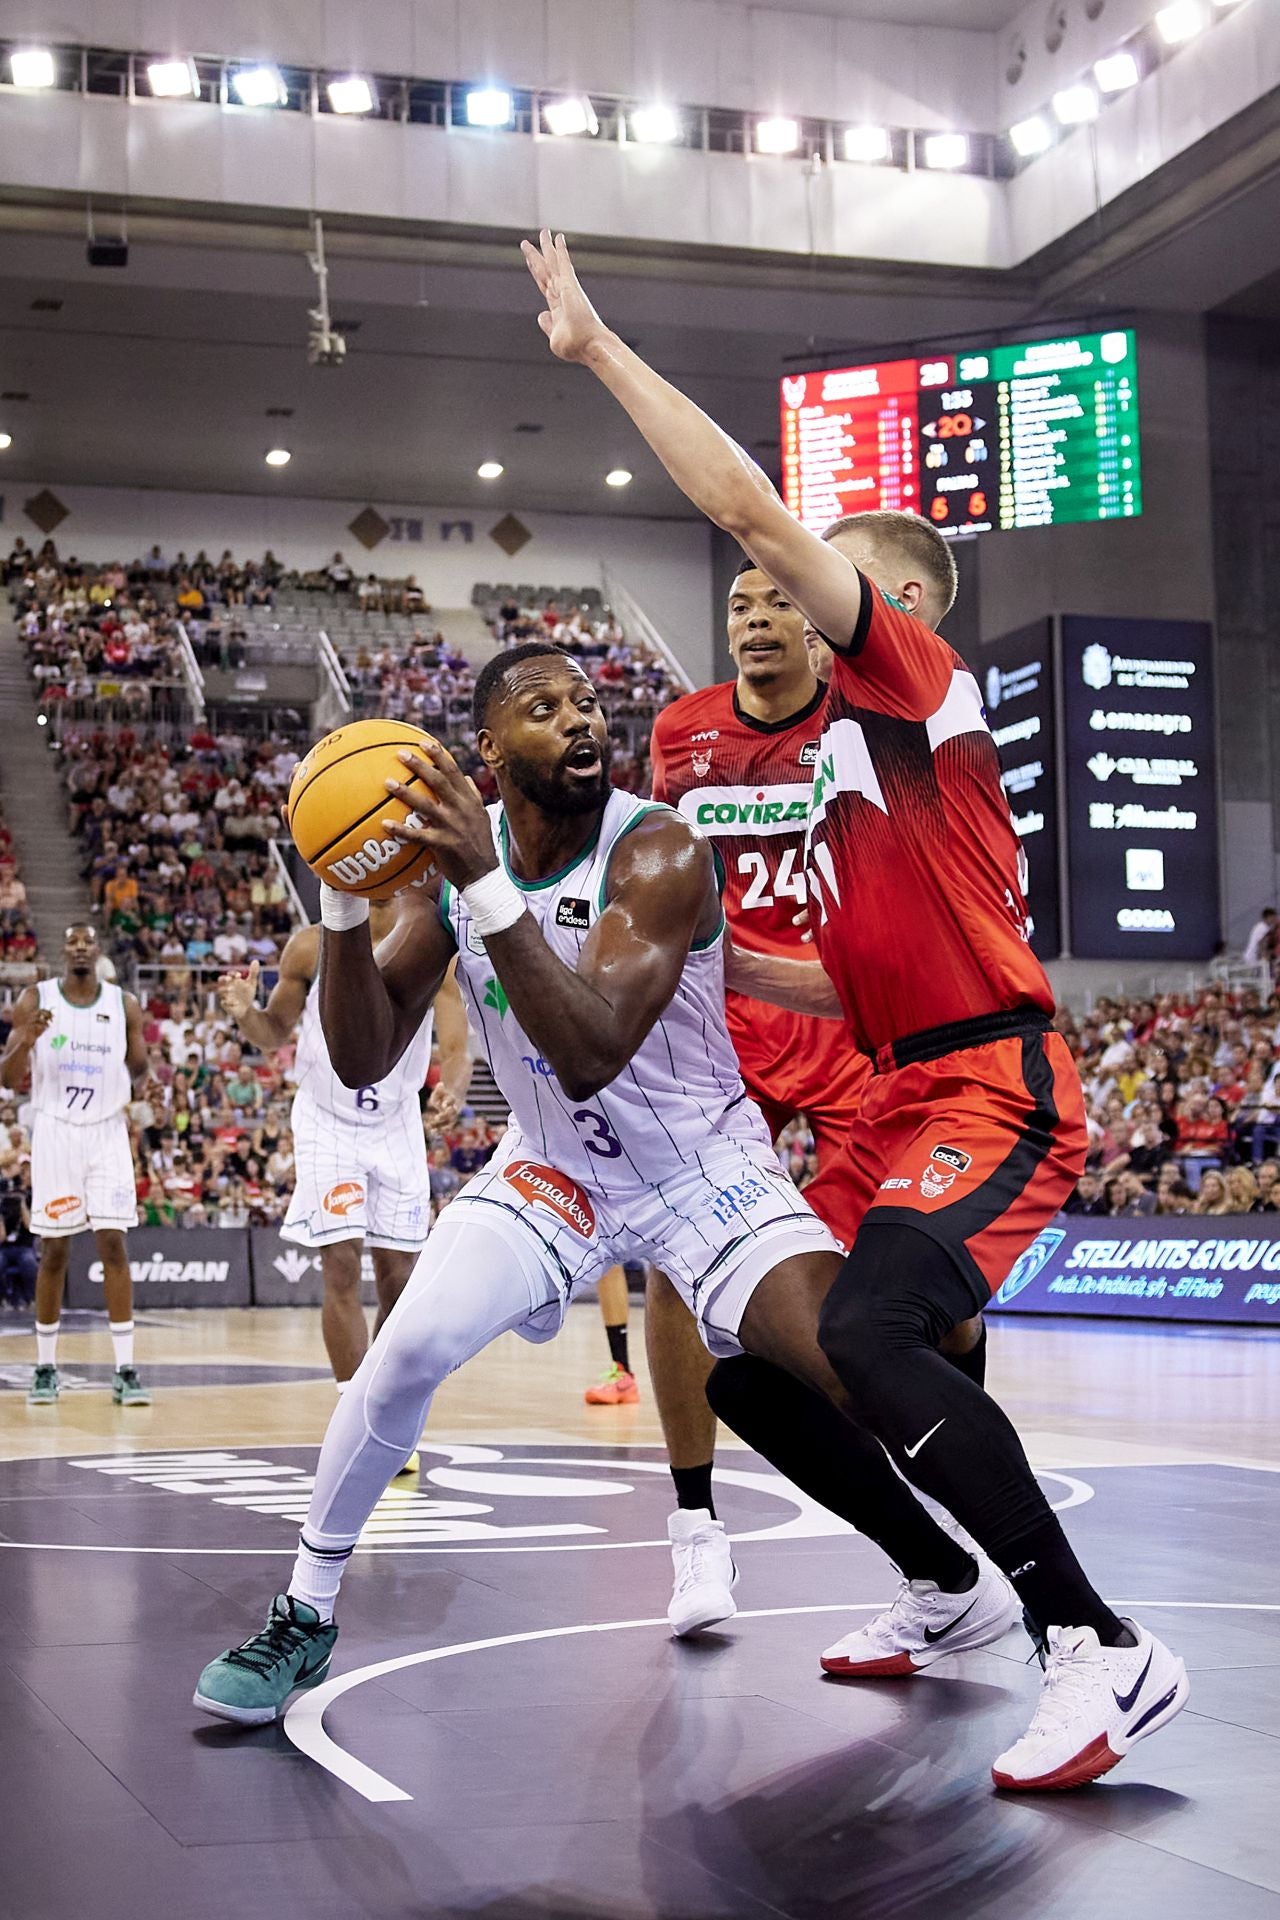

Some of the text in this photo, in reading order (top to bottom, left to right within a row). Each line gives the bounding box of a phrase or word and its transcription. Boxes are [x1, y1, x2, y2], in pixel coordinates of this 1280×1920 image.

[938, 413, 972, 438] 20
[697, 793, 812, 825] COVIRA
[737, 848, 809, 910] 24
[558, 914, 588, 928] endesa
[559, 904, 574, 916] liga
[71, 1040, 112, 1056] Unicaja
[66, 1086, 95, 1111] 77
[356, 1085, 379, 1112] 6
[573, 1109, 623, 1160] 3
[934, 1151, 960, 1166] acb
[504, 1162, 593, 1235] famadesa
[88, 1252, 230, 1283] CVIRAN
